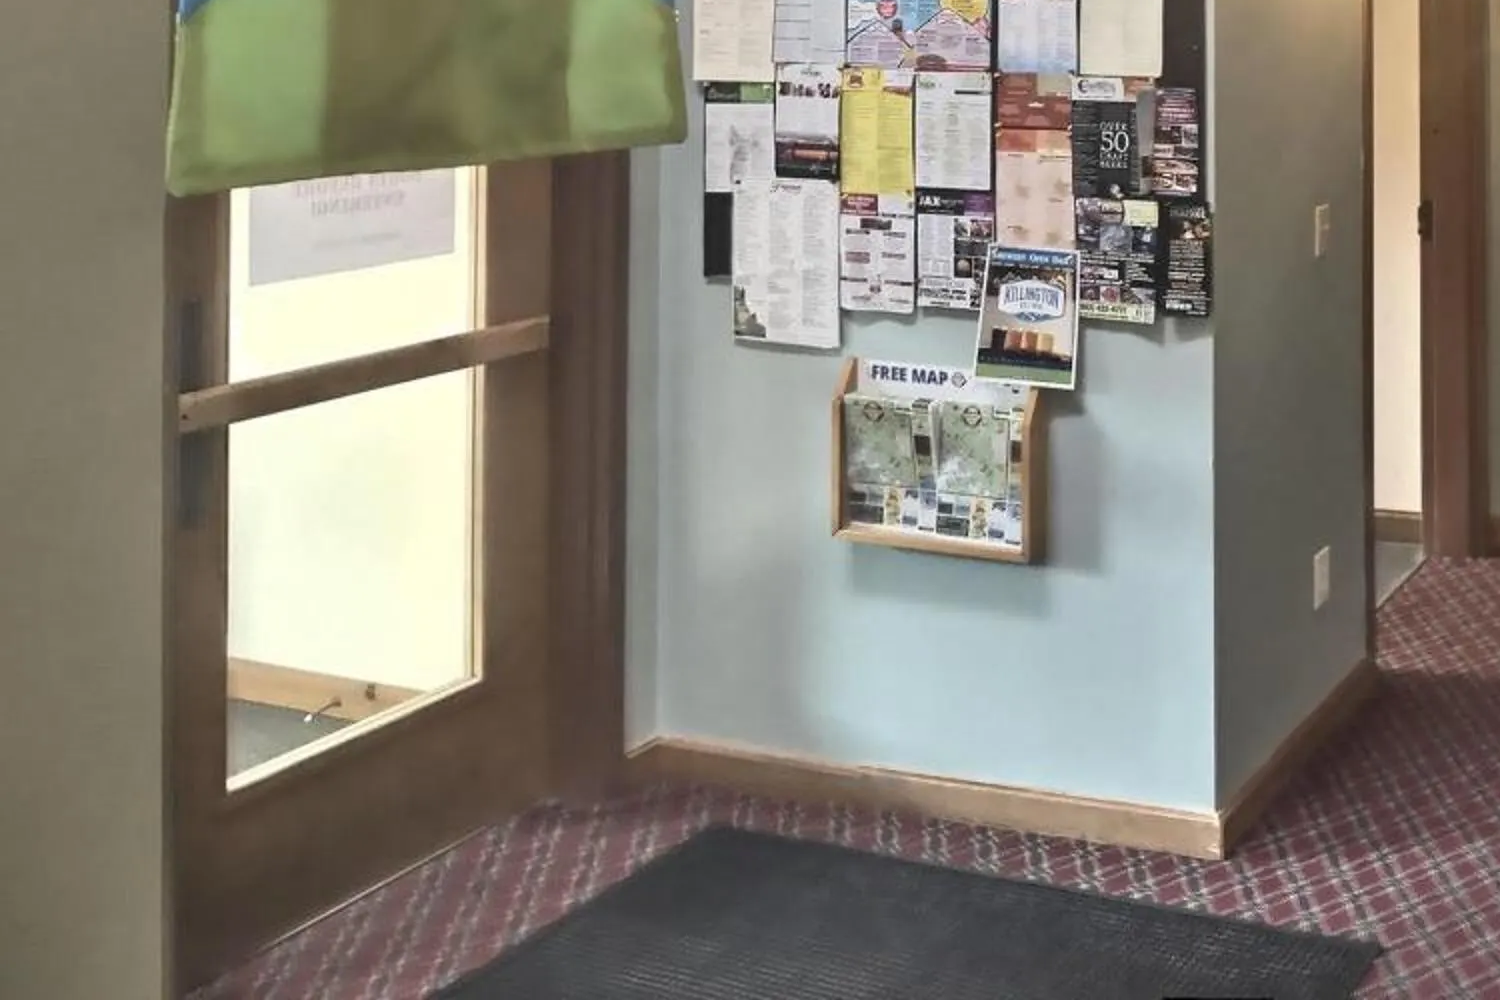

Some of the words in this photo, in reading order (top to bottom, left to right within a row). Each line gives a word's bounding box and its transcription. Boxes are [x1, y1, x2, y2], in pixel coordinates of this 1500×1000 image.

[1100, 121, 1128, 131] OVER
[1101, 131, 1129, 152] 50
[1003, 283, 1061, 312] KILLINGTON
[872, 364, 908, 383] FREE
[911, 367, 949, 385] MAP
